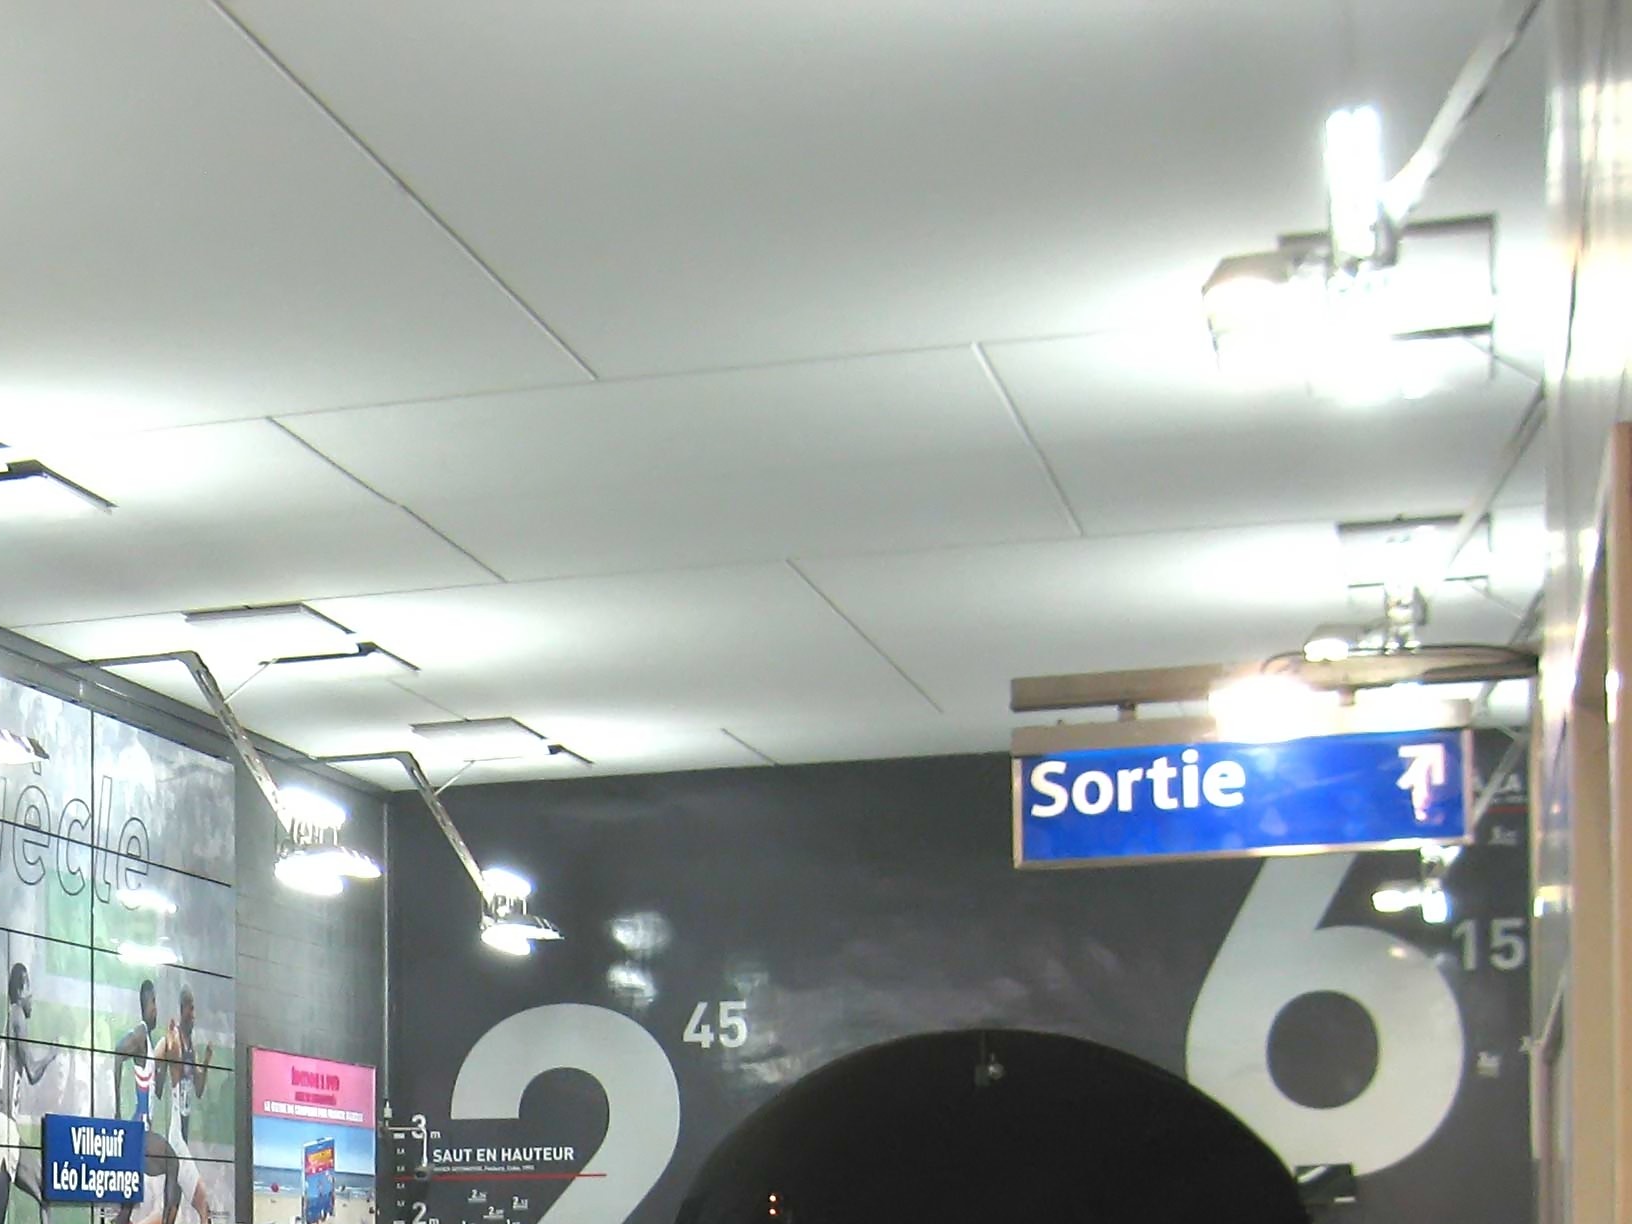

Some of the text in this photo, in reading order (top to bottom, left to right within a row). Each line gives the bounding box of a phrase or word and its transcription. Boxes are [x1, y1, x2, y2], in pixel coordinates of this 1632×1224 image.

[1029, 748, 1246, 818] Sortie
[1452, 917, 1525, 971] 15
[682, 1000, 748, 1049] 45
[71, 1126, 125, 1164] Villejuif
[432, 1146, 575, 1163] SAUT EN HAUTEUR
[53, 1161, 140, 1199] Léo Lagrange
